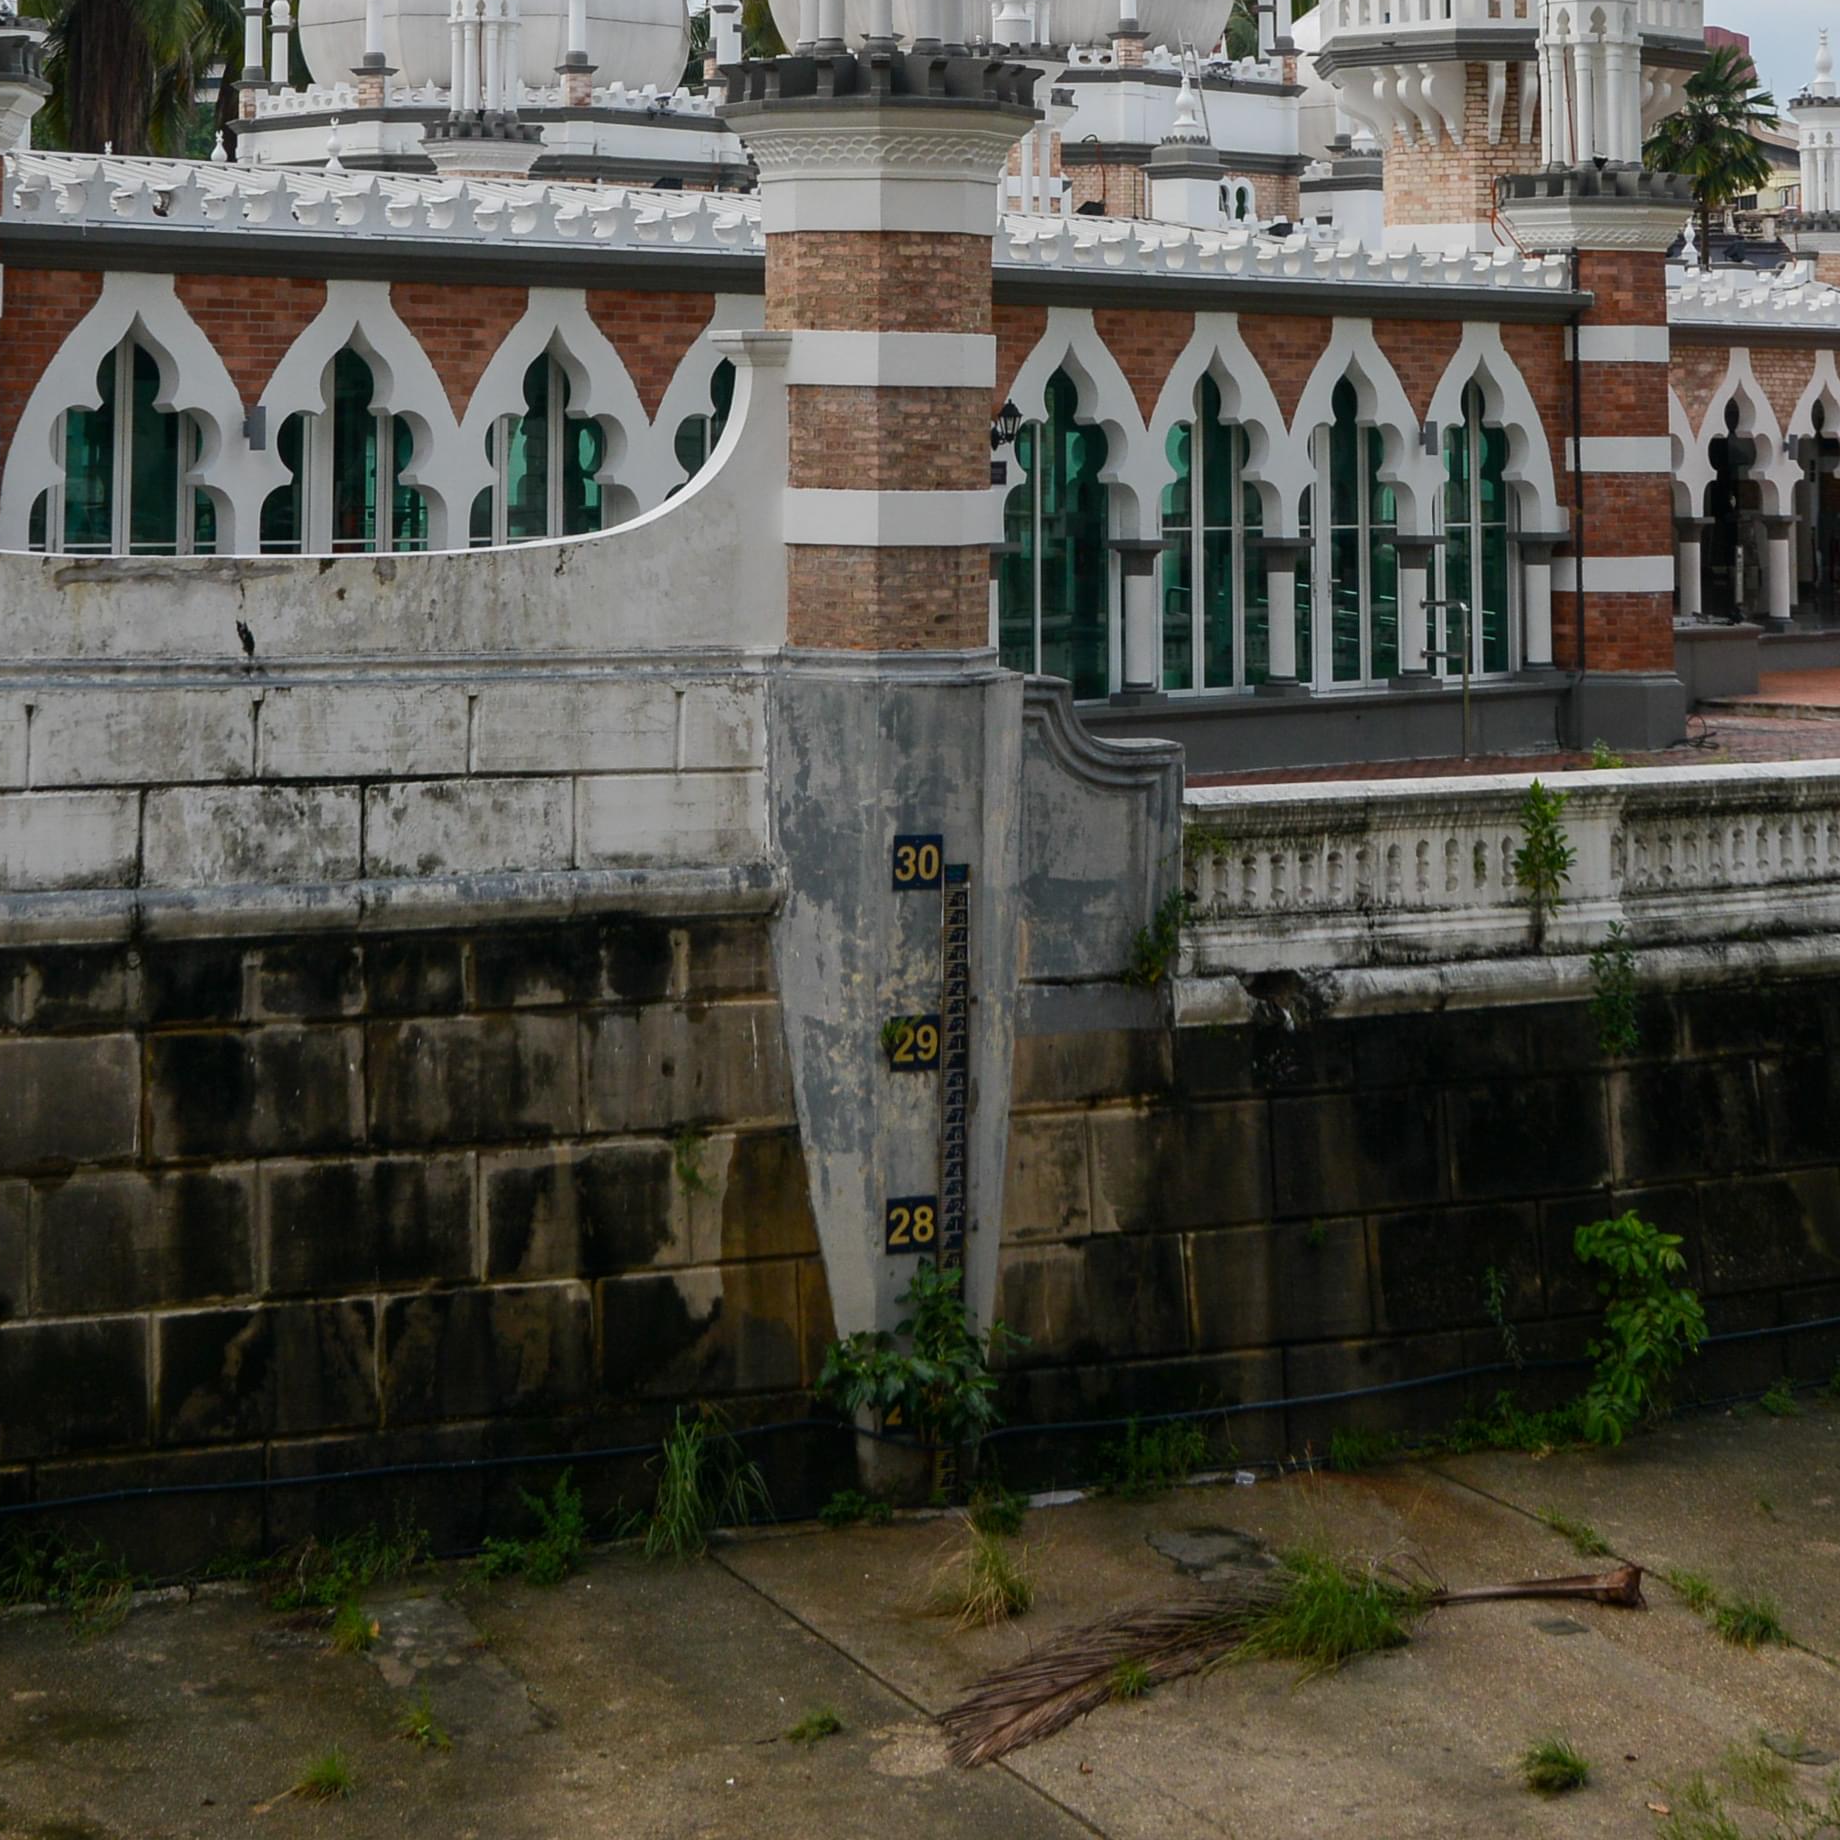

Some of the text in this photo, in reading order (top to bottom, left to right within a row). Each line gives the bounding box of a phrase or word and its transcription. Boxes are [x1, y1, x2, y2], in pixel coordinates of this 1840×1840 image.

[895, 844, 940, 881] 30
[893, 1024, 938, 1062] 29
[888, 1205, 935, 1245] 28
